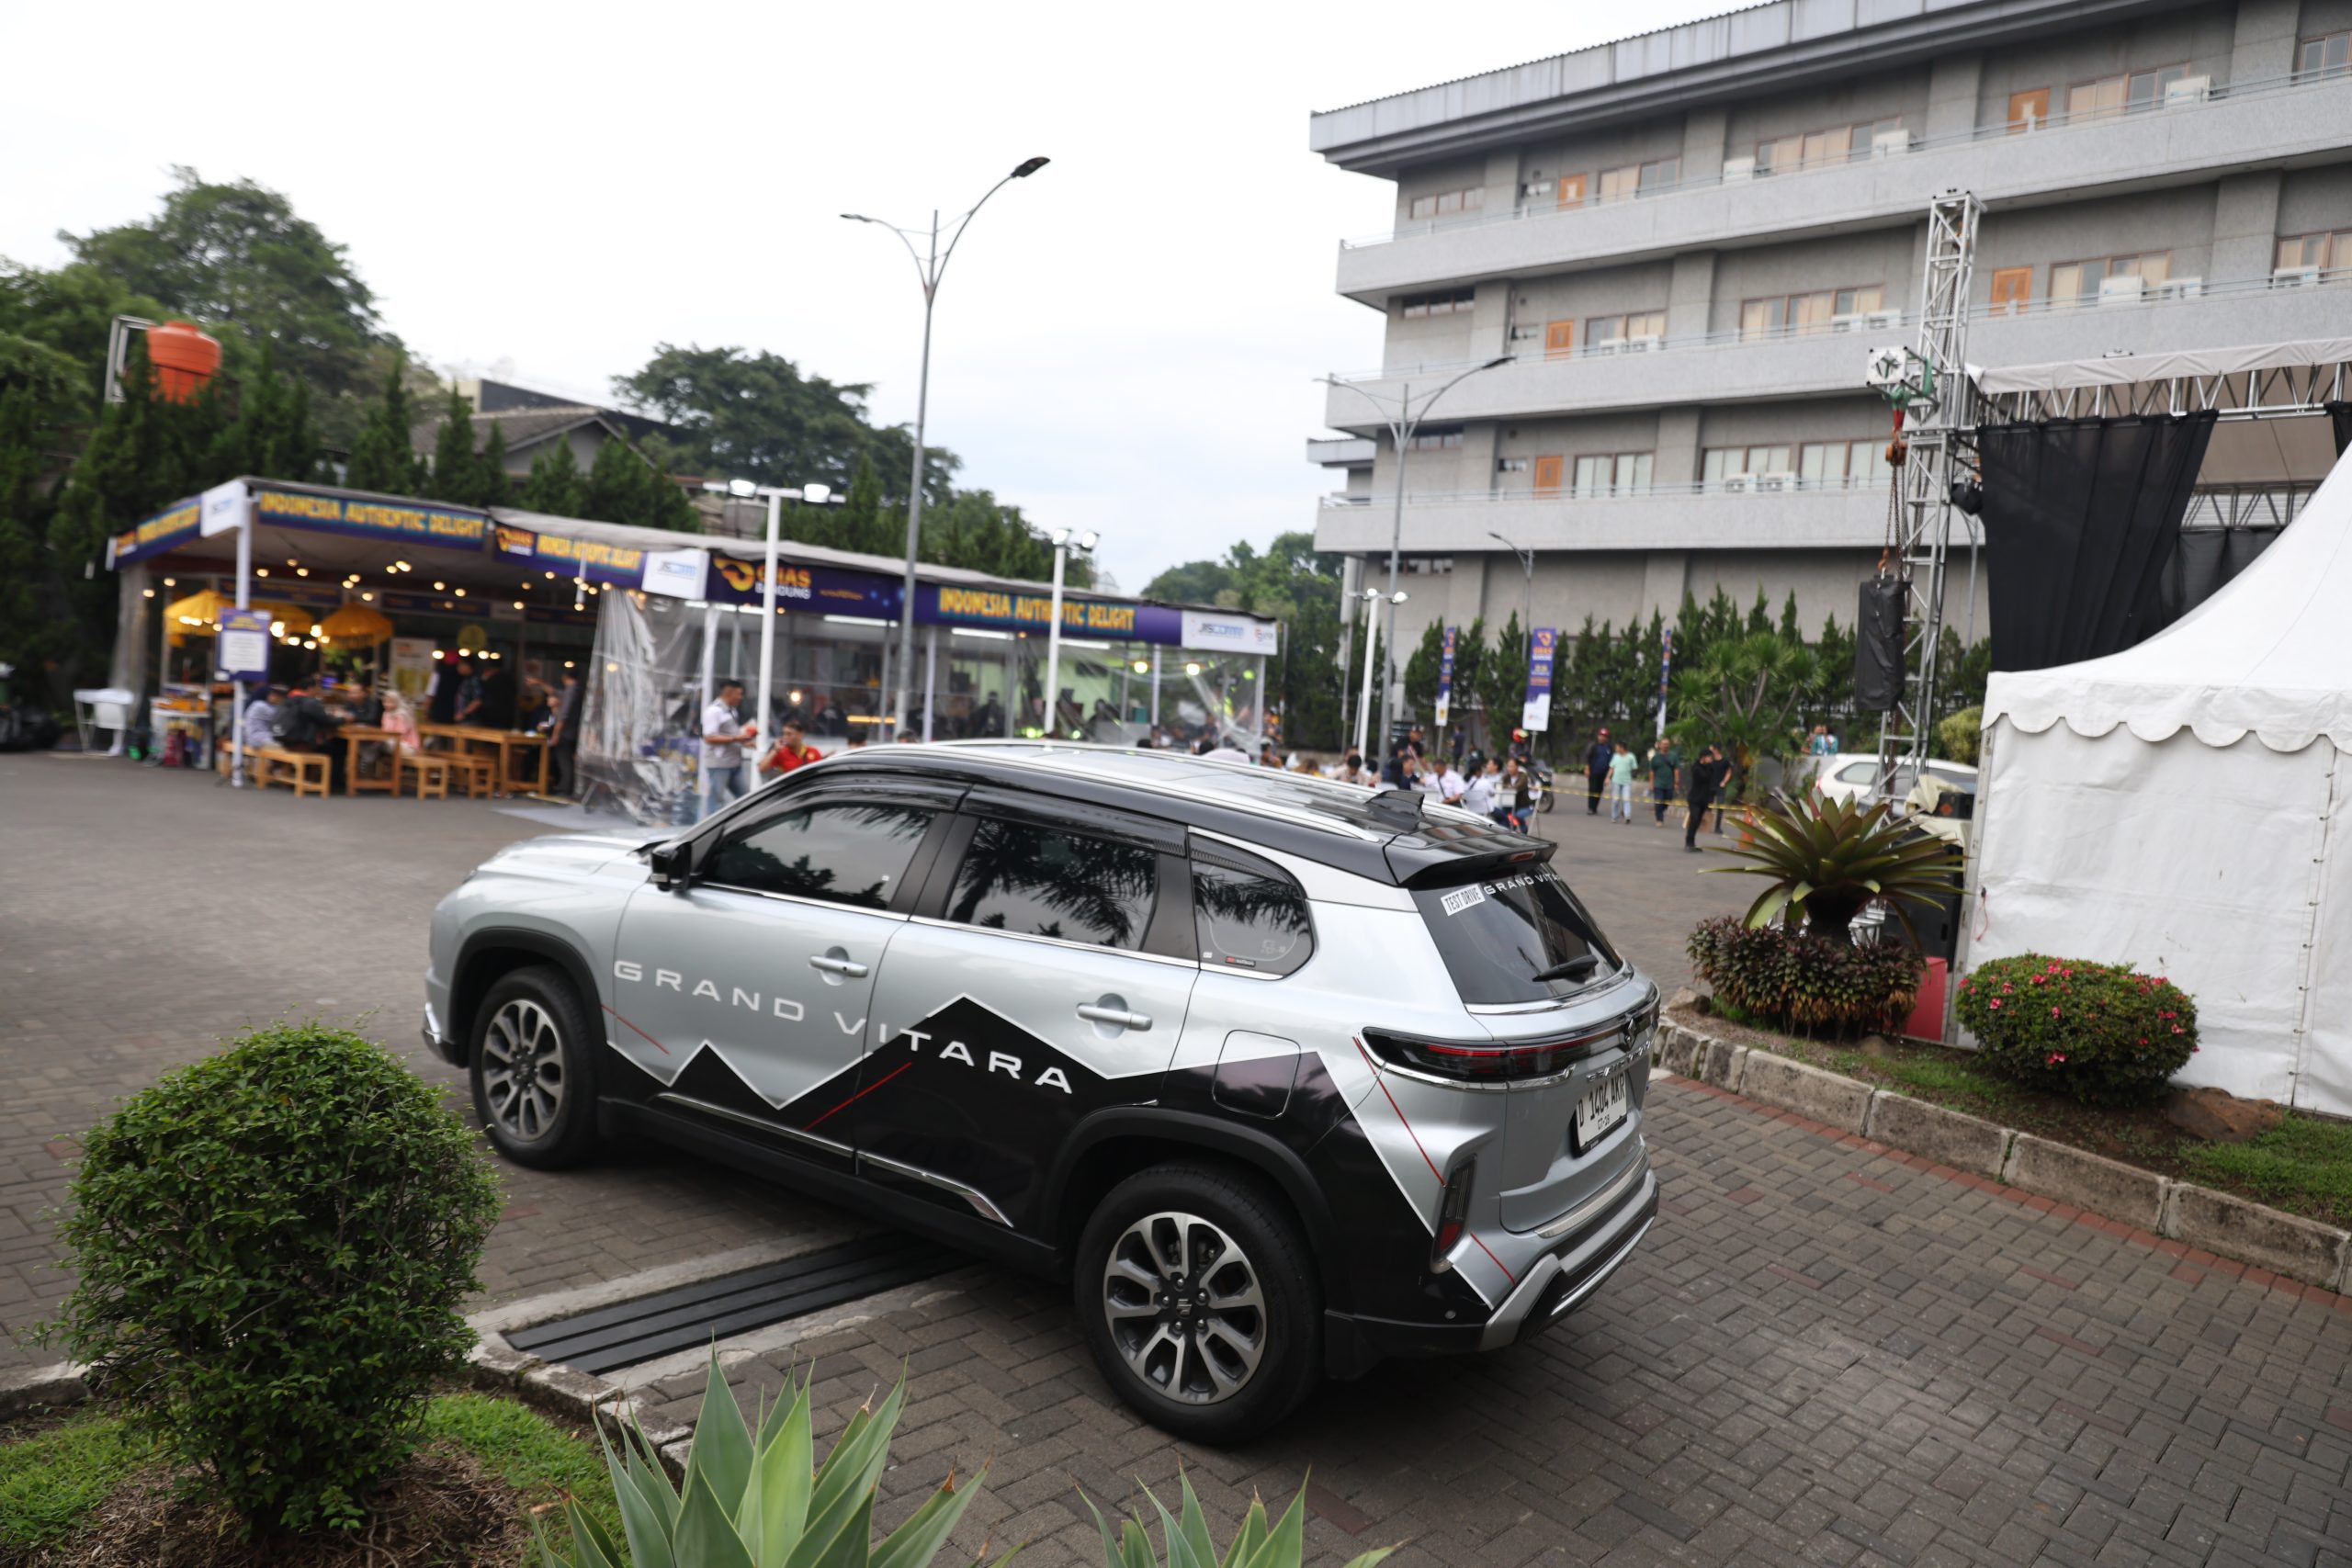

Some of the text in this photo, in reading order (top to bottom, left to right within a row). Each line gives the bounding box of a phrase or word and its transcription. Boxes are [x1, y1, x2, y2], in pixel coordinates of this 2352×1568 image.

[939, 587, 1011, 616] INDONESIA
[1088, 604, 1136, 631] DELIGHT
[1445, 887, 1481, 911] TEST DRIVE
[1484, 876, 1534, 895] GRAND
[614, 961, 1073, 1094] GRAND VITARA
